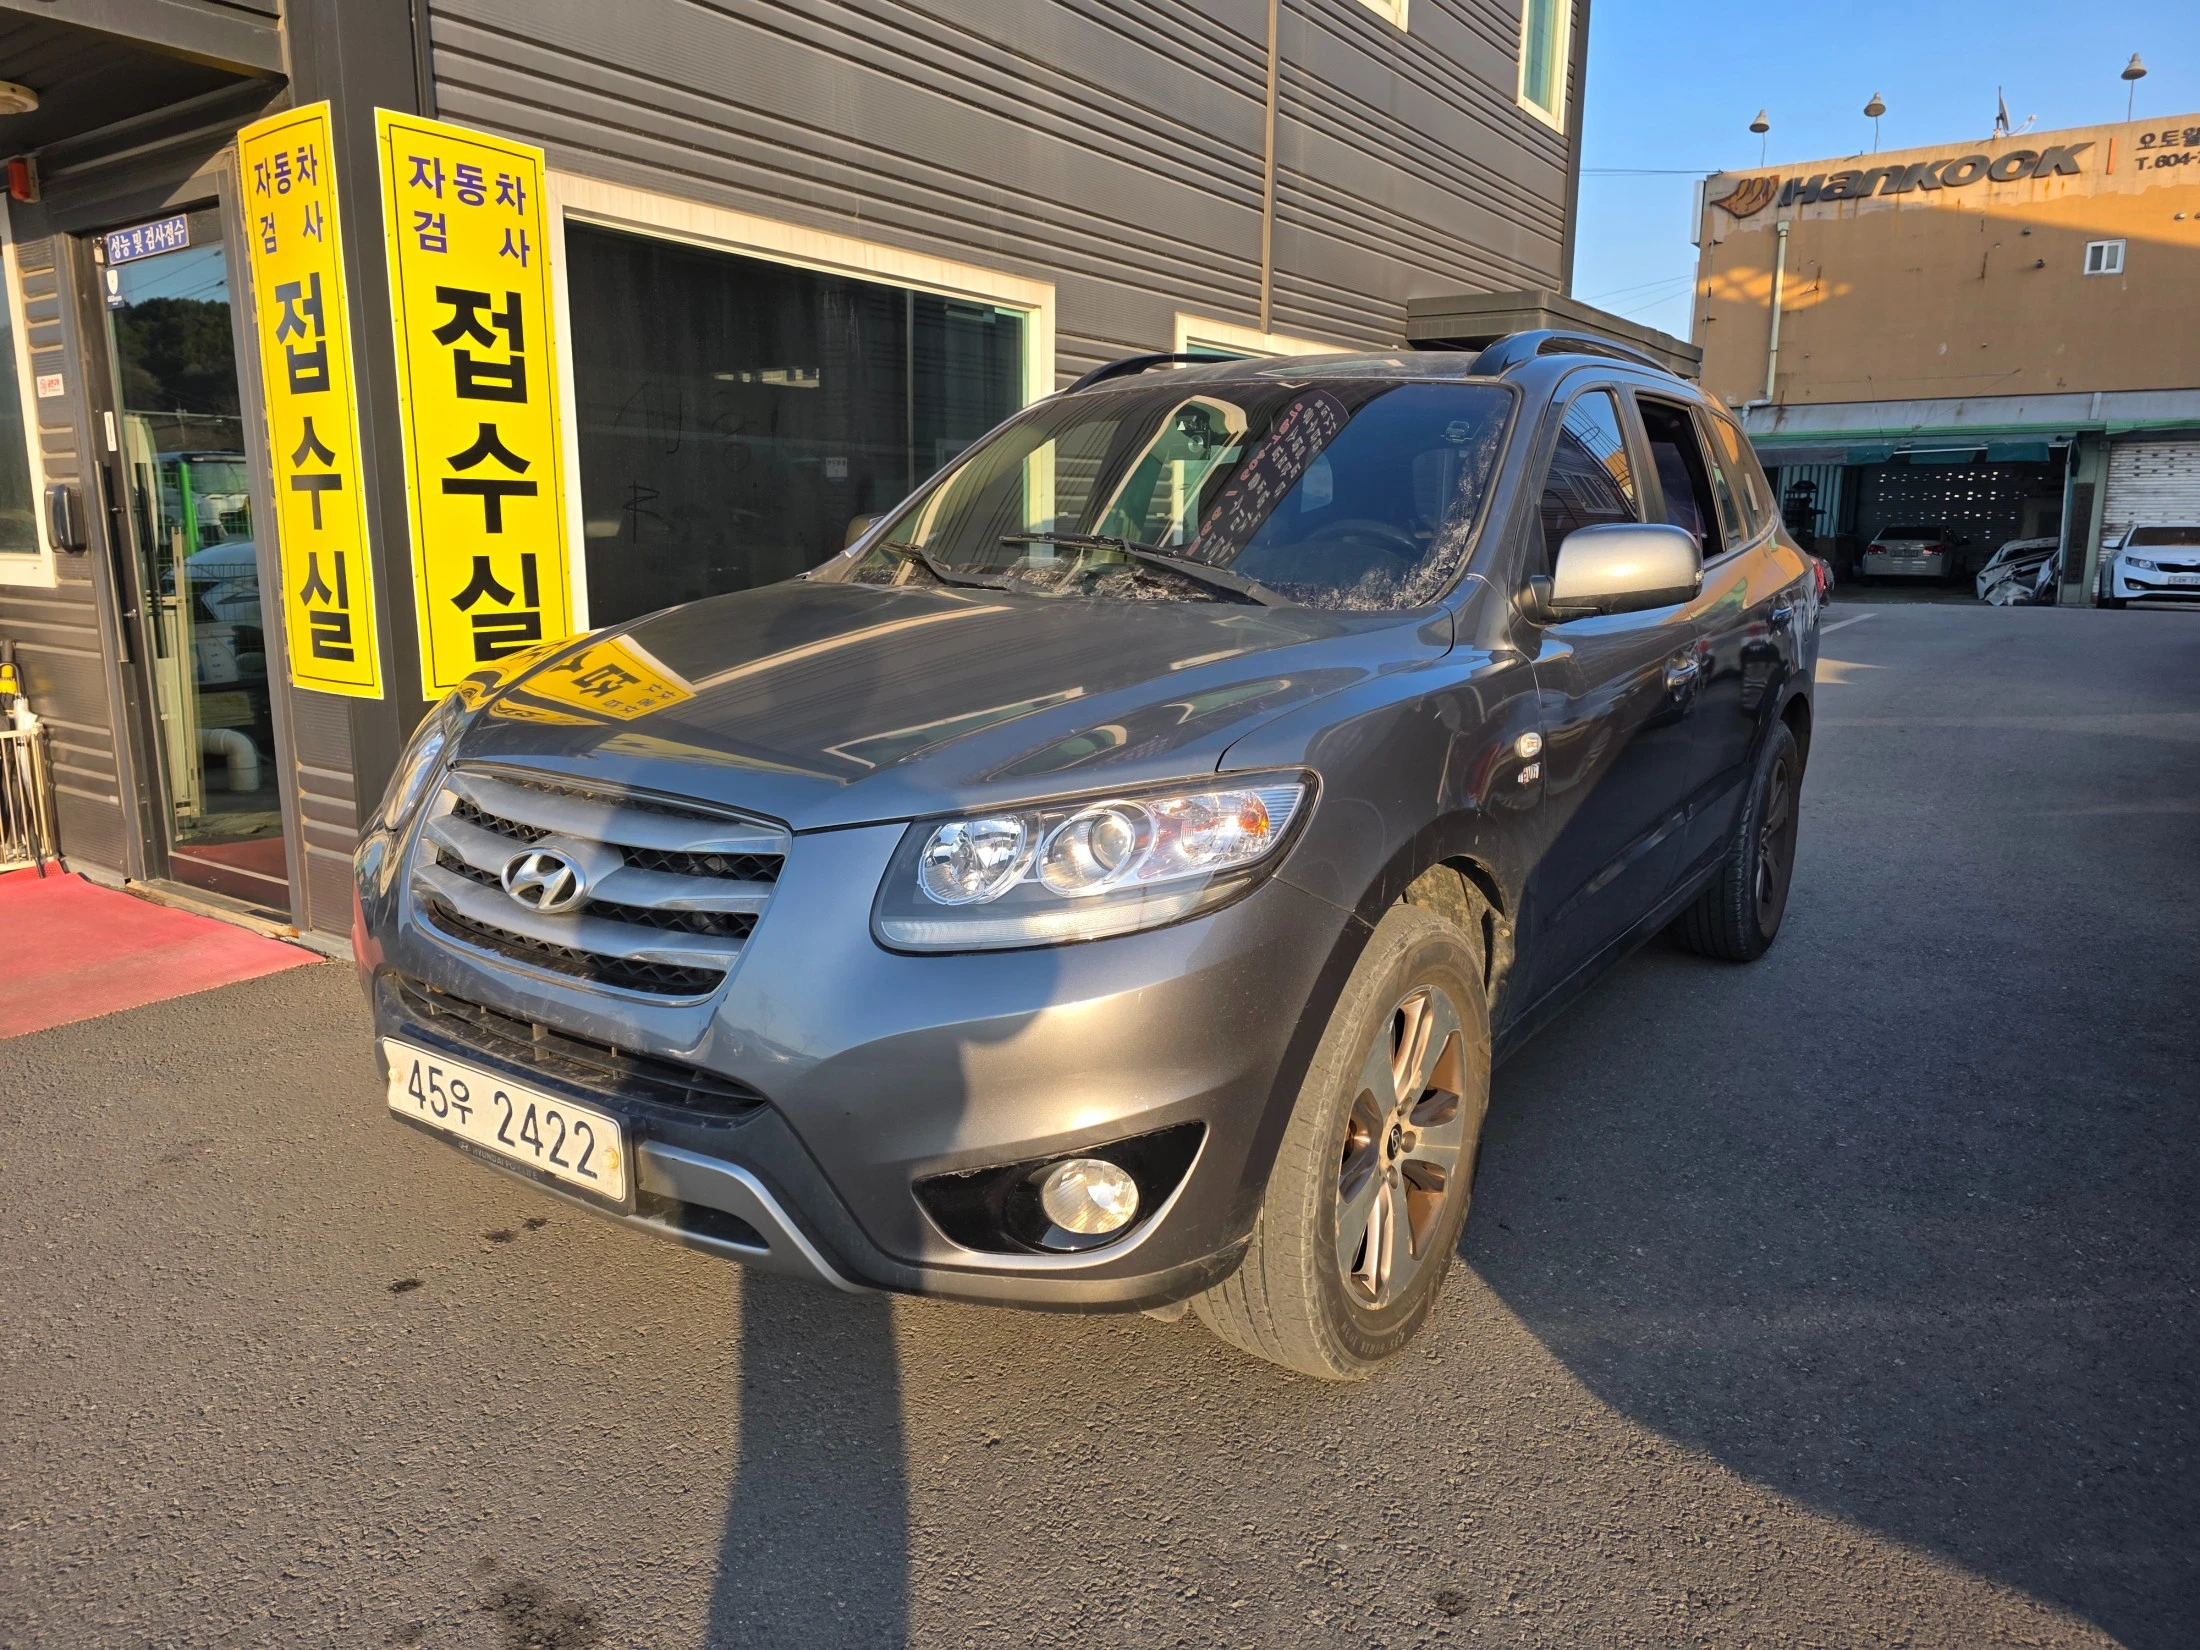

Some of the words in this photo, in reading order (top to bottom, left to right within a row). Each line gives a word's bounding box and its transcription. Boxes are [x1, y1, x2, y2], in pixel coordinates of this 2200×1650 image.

[255, 143, 319, 200] 자동차
[408, 153, 527, 216] 자동차
[2134, 152, 2200, 171] T.604-
[111, 235, 131, 259] 성능
[132, 229, 144, 255] 및
[145, 219, 185, 251] 검사접수
[275, 272, 356, 663] 접수실
[431, 285, 543, 663] 접수실
[408, 1059, 474, 1125] 45우
[493, 1090, 598, 1179] 2422
[472, 1148, 504, 1166] HYUNDAI
